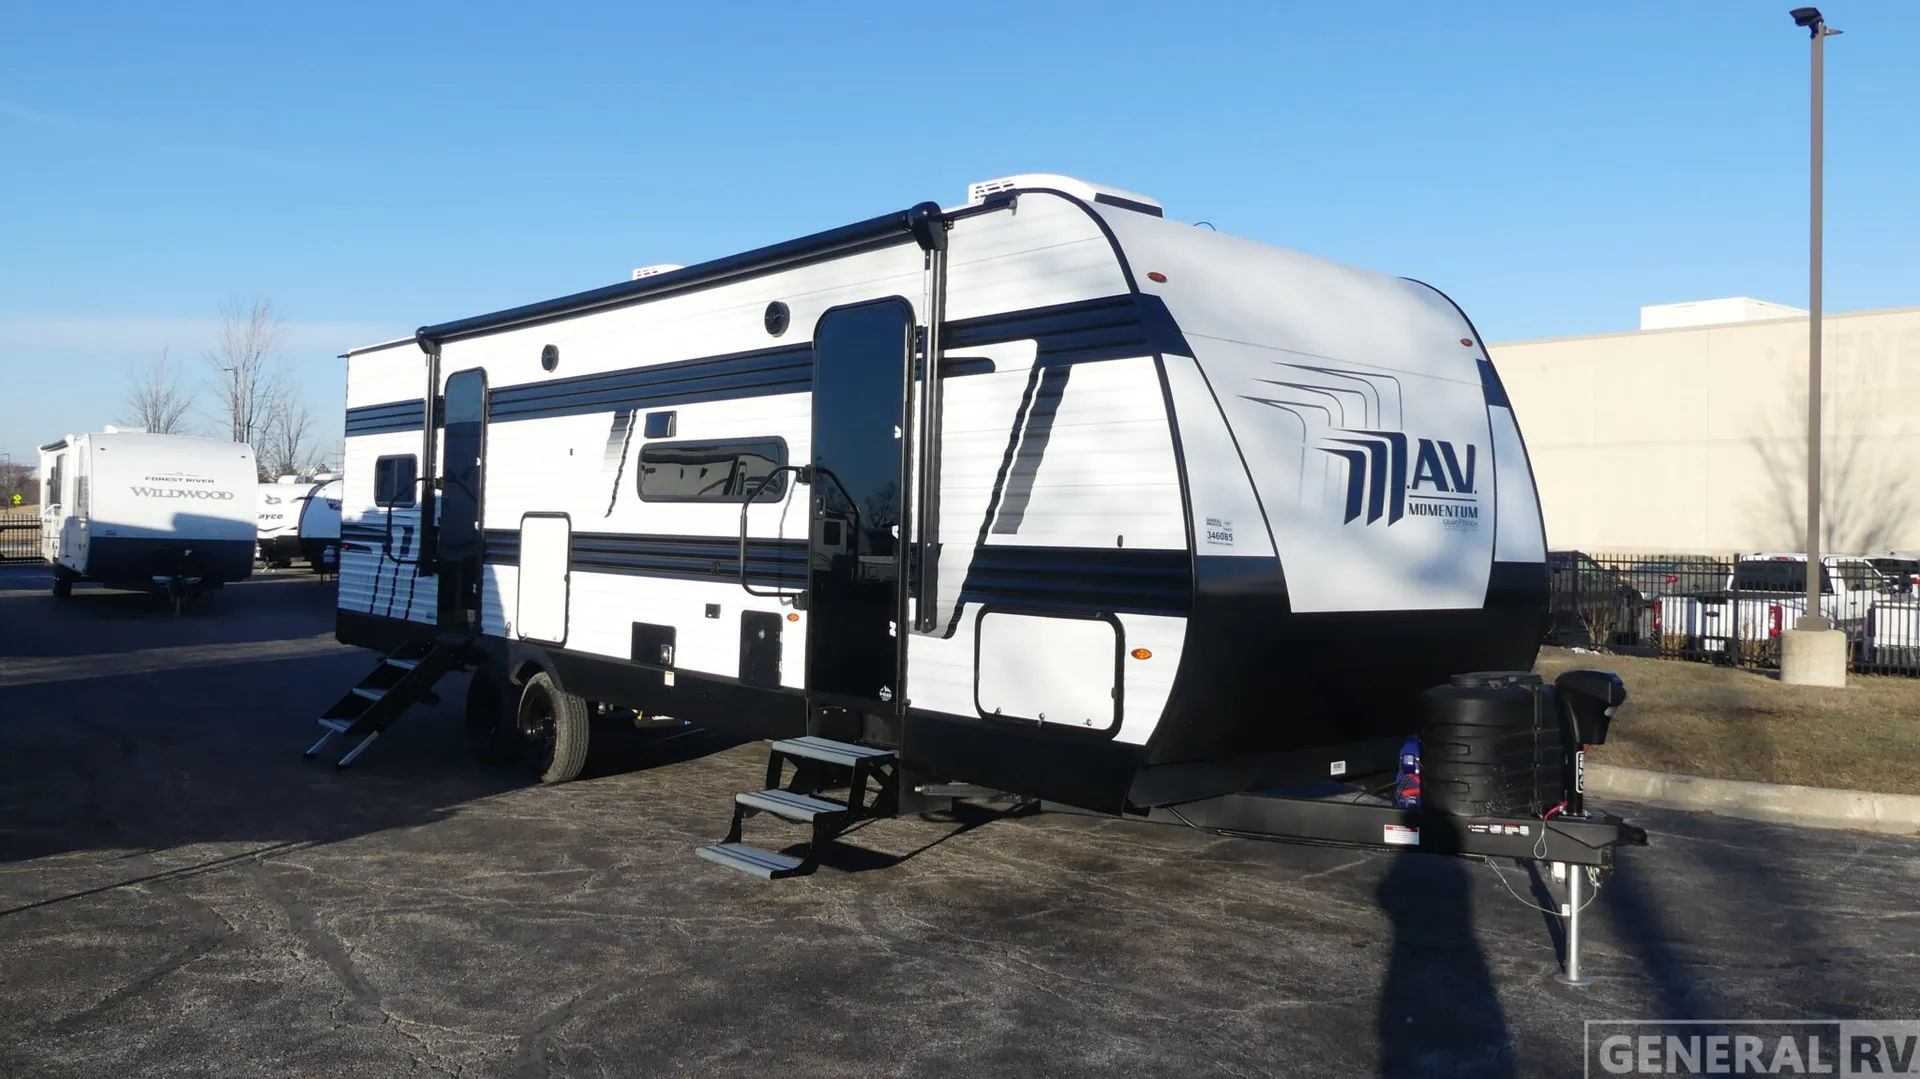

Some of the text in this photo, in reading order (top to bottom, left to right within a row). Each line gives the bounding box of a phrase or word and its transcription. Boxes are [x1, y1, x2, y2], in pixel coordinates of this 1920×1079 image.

[129, 486, 234, 500] WILDWOOD
[257, 512, 284, 520] ayco
[1408, 502, 1478, 518] MOMENTUM
[1207, 531, 1233, 541] 346085
